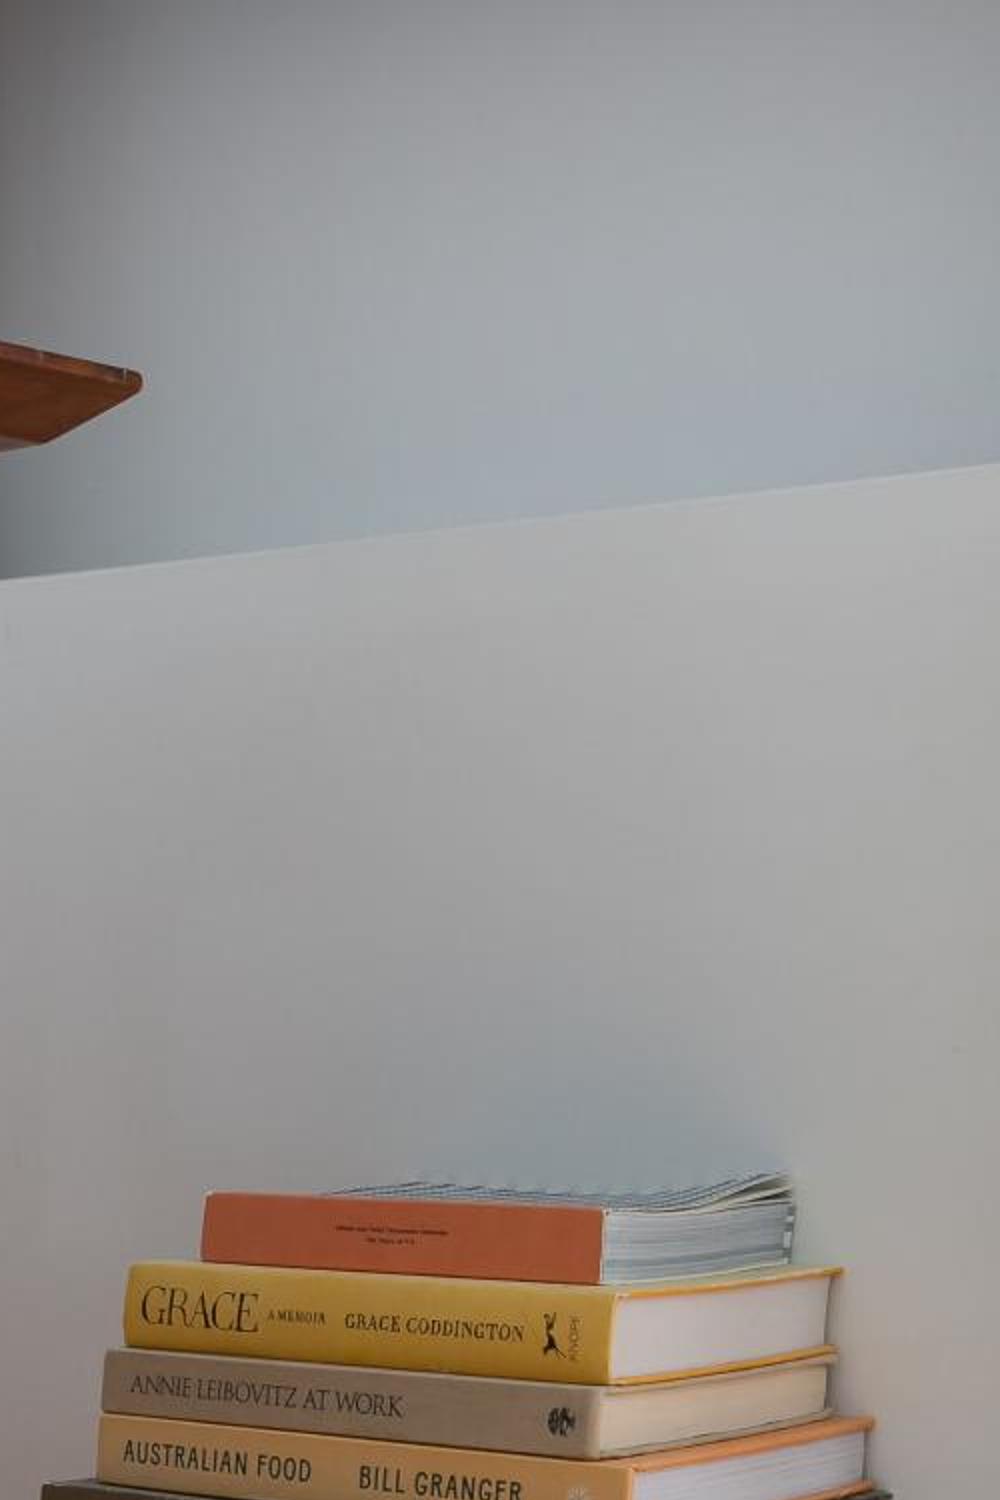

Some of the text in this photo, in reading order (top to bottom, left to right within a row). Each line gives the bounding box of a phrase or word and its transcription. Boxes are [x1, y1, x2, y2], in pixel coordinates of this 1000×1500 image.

[141, 1285, 259, 1333] GRACE
[276, 1309, 326, 1326] MEMOIR
[345, 1313, 524, 1343] GRACE CODDINGTON
[131, 1374, 404, 1419] ANNIE LEIBOVITZ AT WORK
[123, 1438, 311, 1484] AUSTRALIAN FOOD
[359, 1465, 405, 1495] BILL
